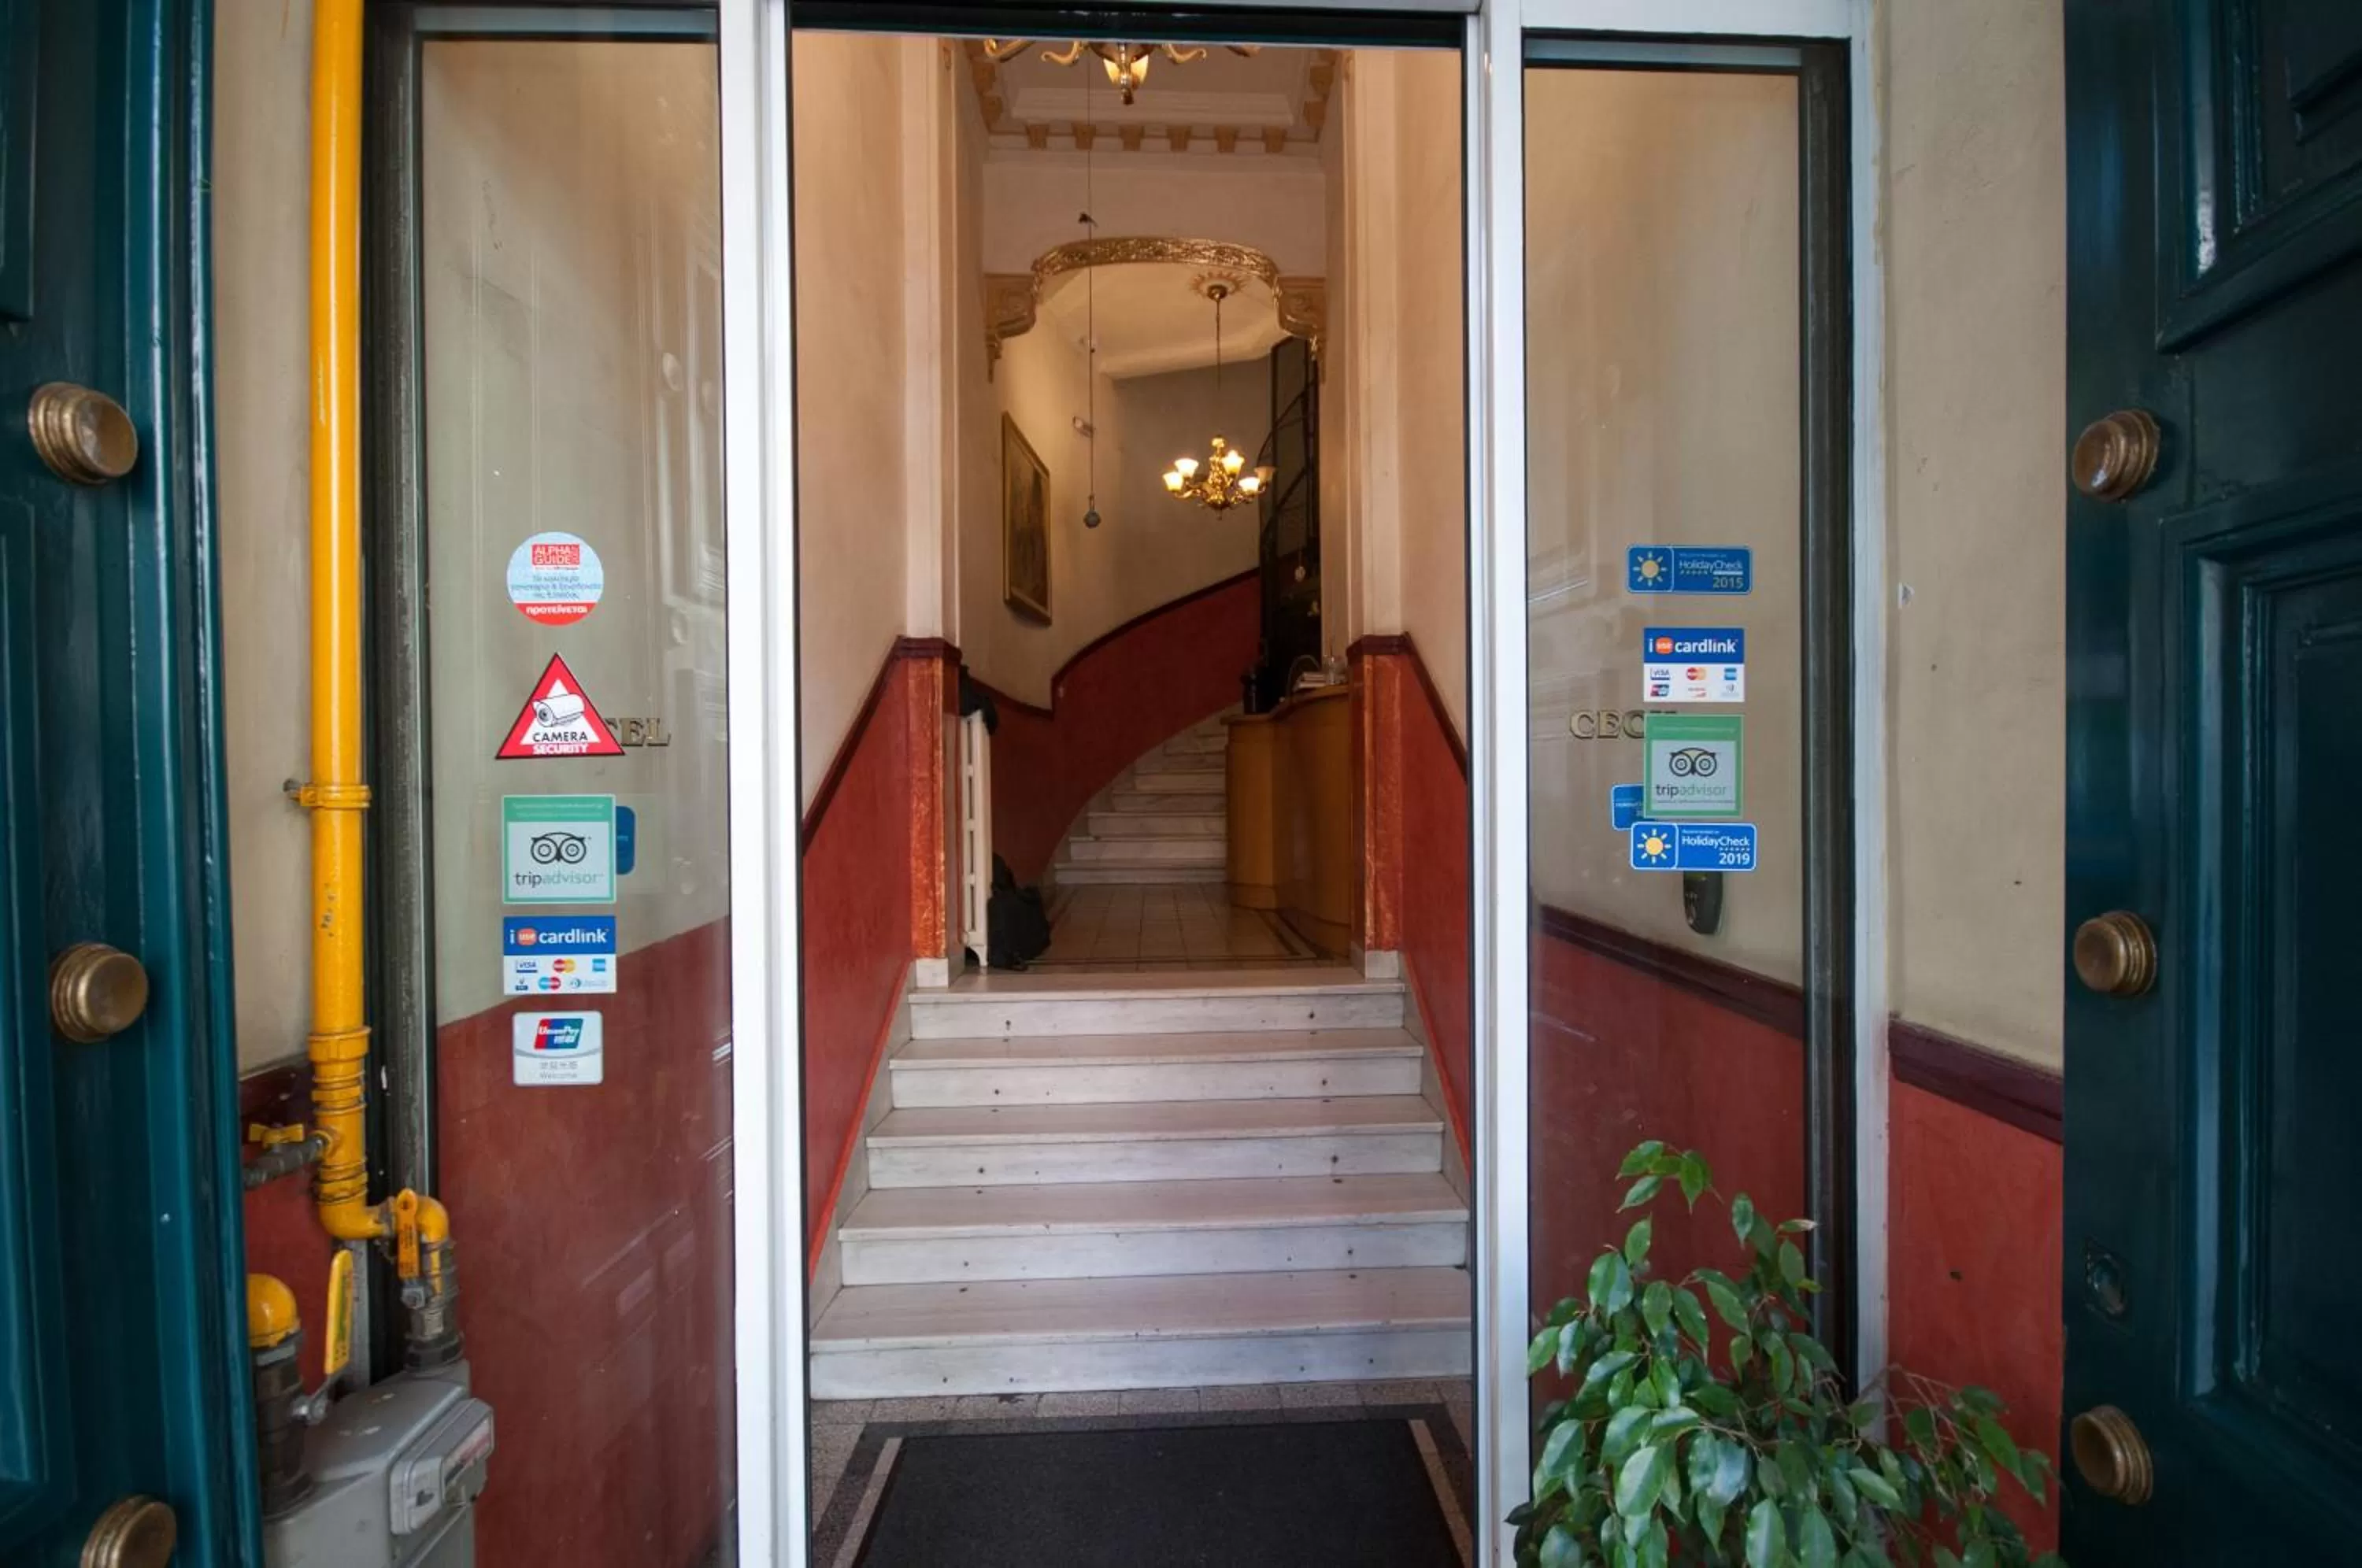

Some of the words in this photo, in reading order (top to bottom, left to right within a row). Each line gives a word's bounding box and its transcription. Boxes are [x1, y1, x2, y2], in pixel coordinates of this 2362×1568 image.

[535, 545, 572, 554] ALPHA
[535, 555, 572, 564] GUIDE
[1679, 560, 1742, 572] HolidayCheck
[1712, 577, 1743, 589] 2015
[1648, 638, 1653, 653] i
[1675, 638, 1736, 653] cardlink
[532, 731, 589, 742] CAMERA
[532, 744, 589, 755] SECURITY
[1656, 783, 1727, 798] tripadvisor
[1682, 836, 1750, 849] HolidayCheck
[1719, 852, 1750, 864] 2019
[514, 871, 598, 888] tripadvisor
[509, 930, 515, 944] i
[539, 928, 606, 944] cardlink
